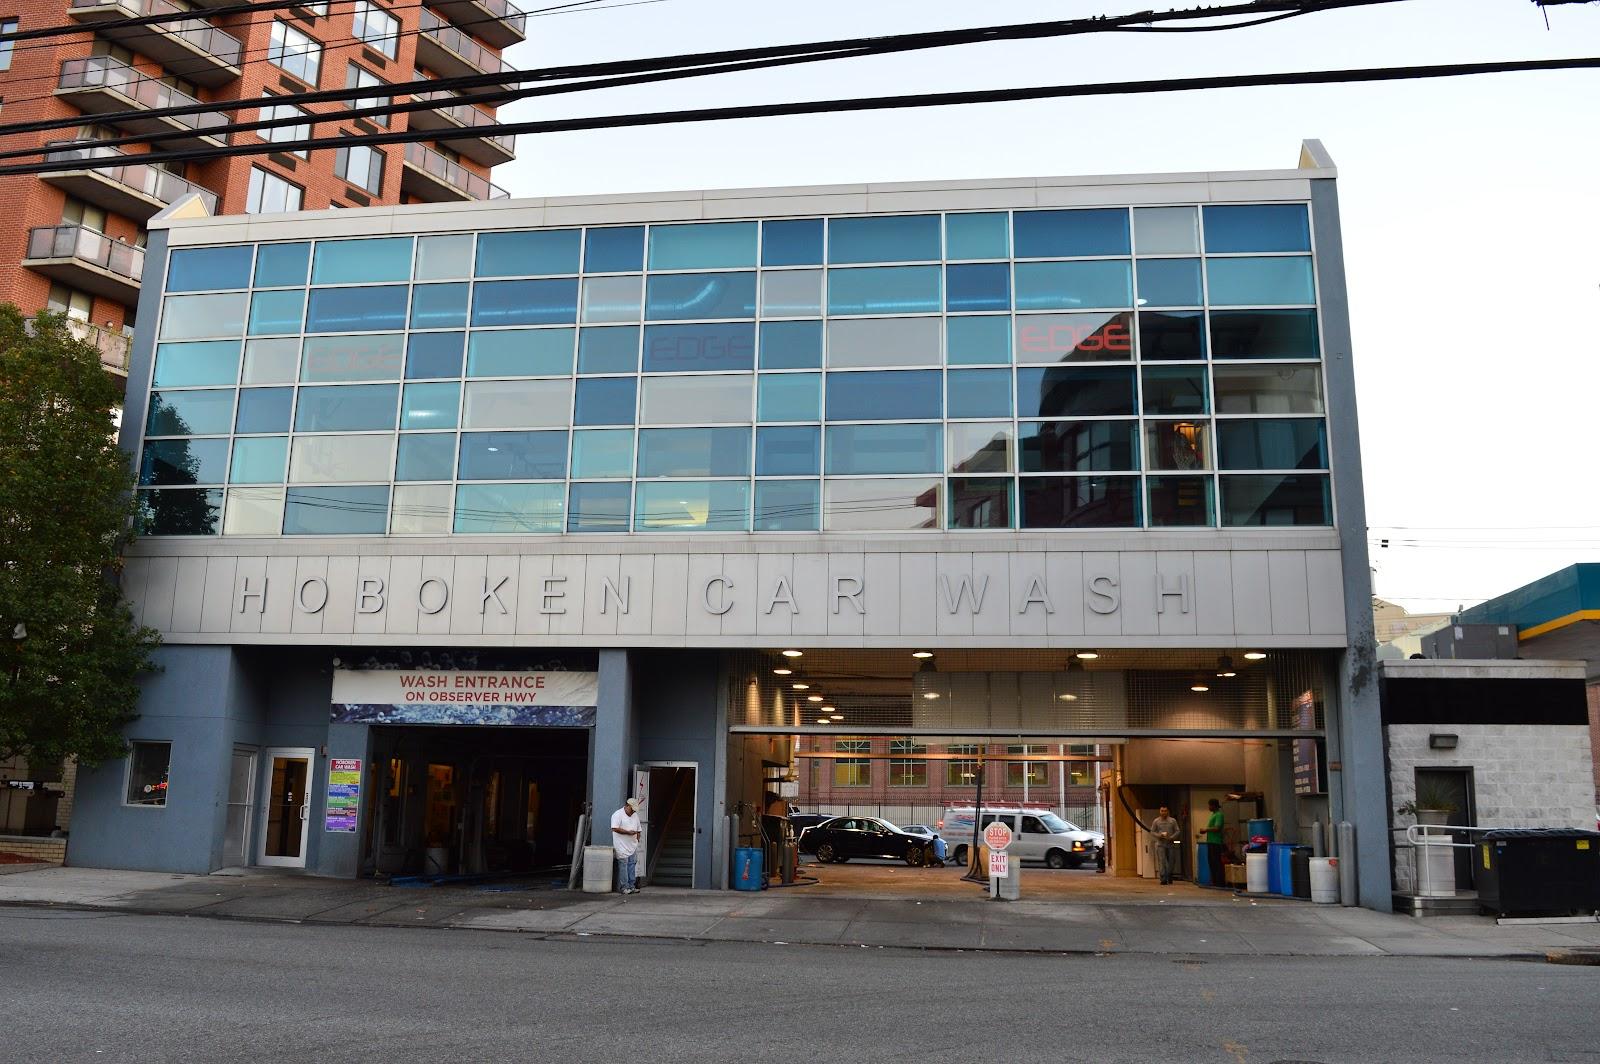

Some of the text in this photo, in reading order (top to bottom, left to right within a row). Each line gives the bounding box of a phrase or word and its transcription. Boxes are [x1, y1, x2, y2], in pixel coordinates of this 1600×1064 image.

[1021, 324, 1131, 352] EDGE
[238, 574, 1190, 615] HOBOKEN CAR WASH
[400, 675, 545, 689] WASH ENTRANCE
[405, 691, 537, 703] ON OBSERVER HWY
[989, 827, 1007, 836] STOP
[991, 855, 1006, 863] EXIT
[991, 864, 1006, 873] ONLY
